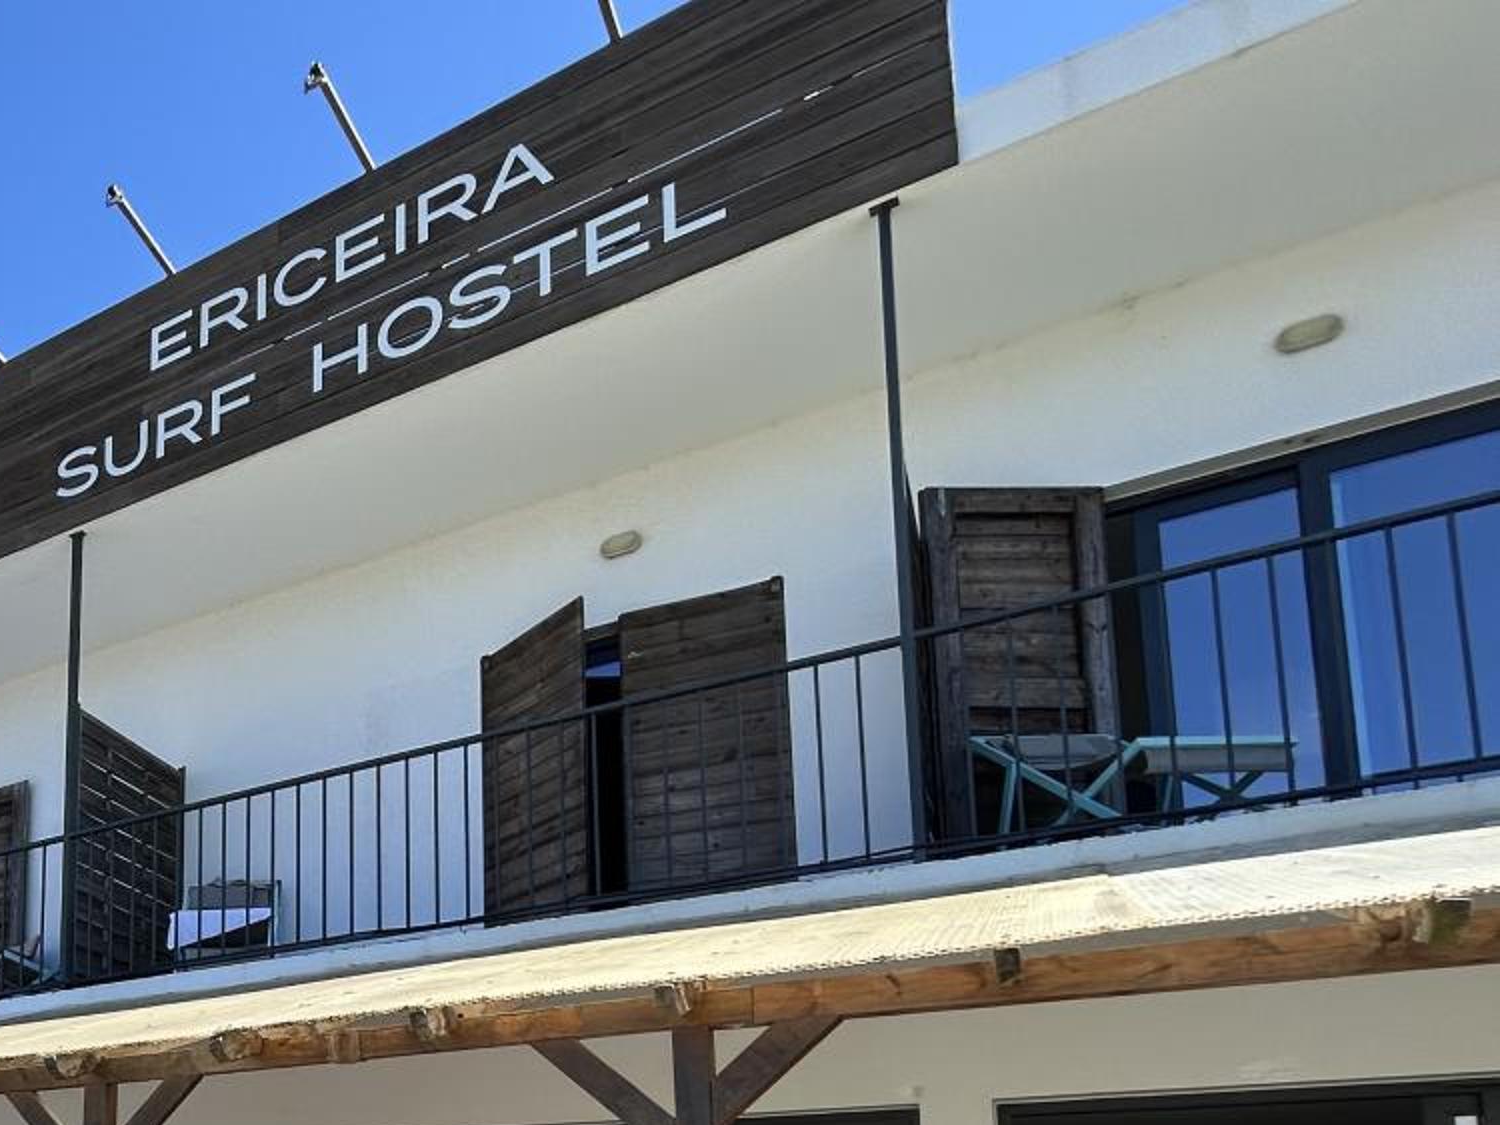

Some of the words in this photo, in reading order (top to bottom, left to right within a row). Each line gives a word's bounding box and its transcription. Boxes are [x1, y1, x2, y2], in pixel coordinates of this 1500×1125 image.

[55, 373, 258, 498] SURF
[312, 182, 728, 393] HOSTEL
[150, 143, 555, 371] ERICEIRA
